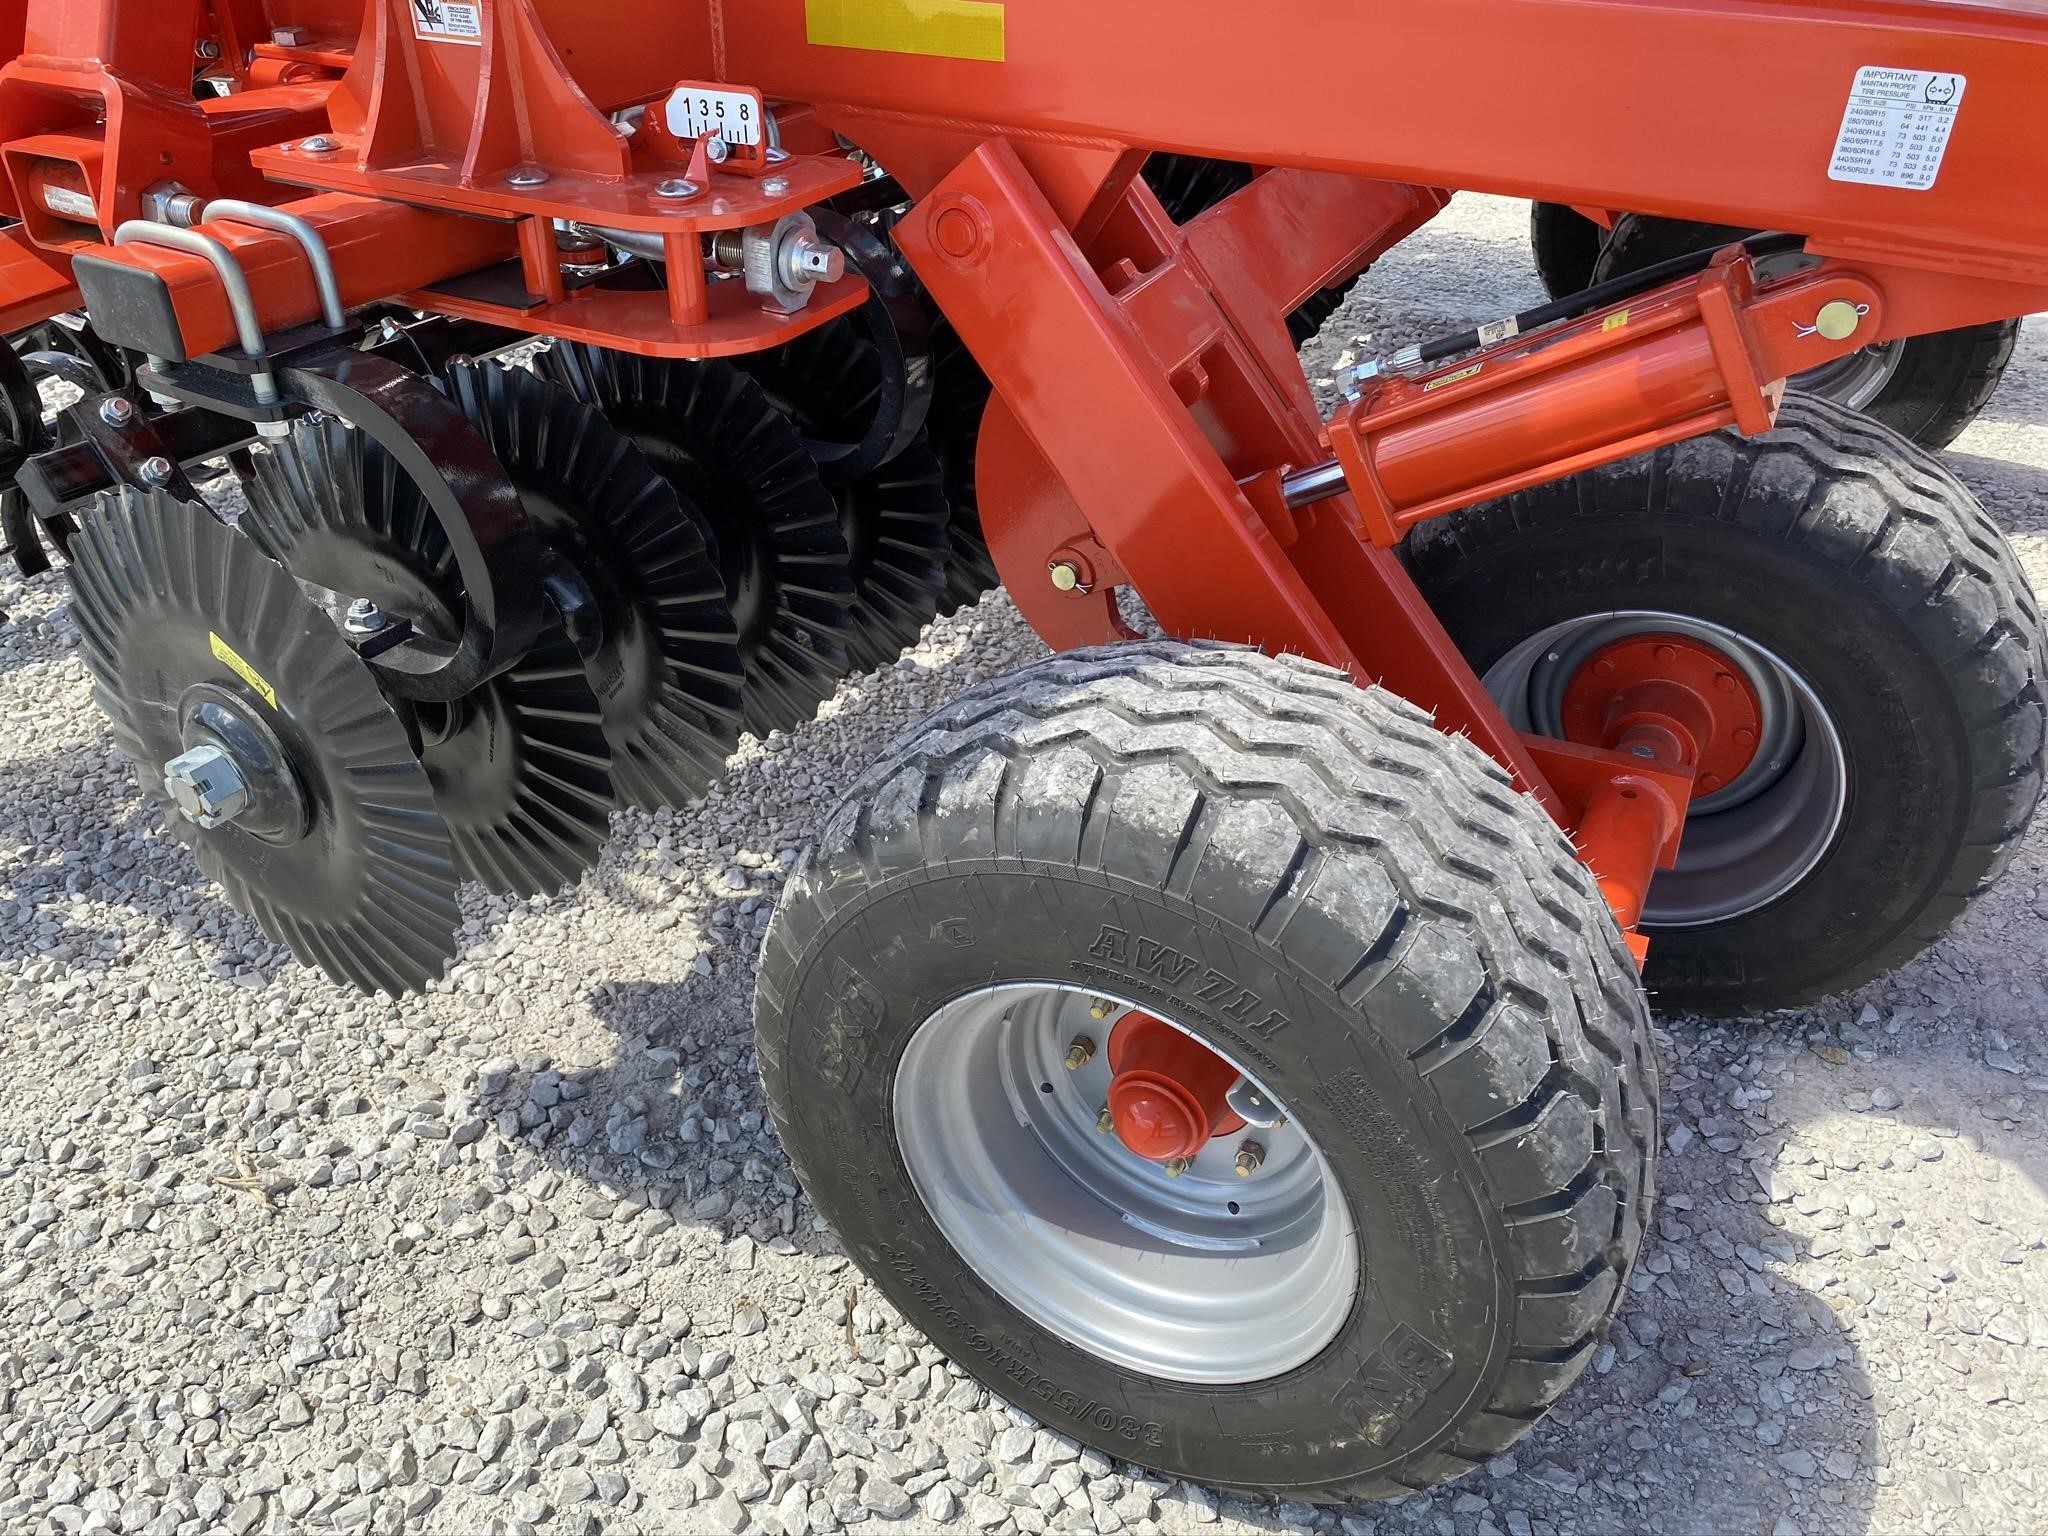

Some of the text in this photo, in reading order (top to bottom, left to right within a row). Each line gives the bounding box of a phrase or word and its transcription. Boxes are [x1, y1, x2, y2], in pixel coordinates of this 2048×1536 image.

[1876, 90, 1910, 98] PRESSURE
[683, 97, 750, 121] 1 3 5 8
